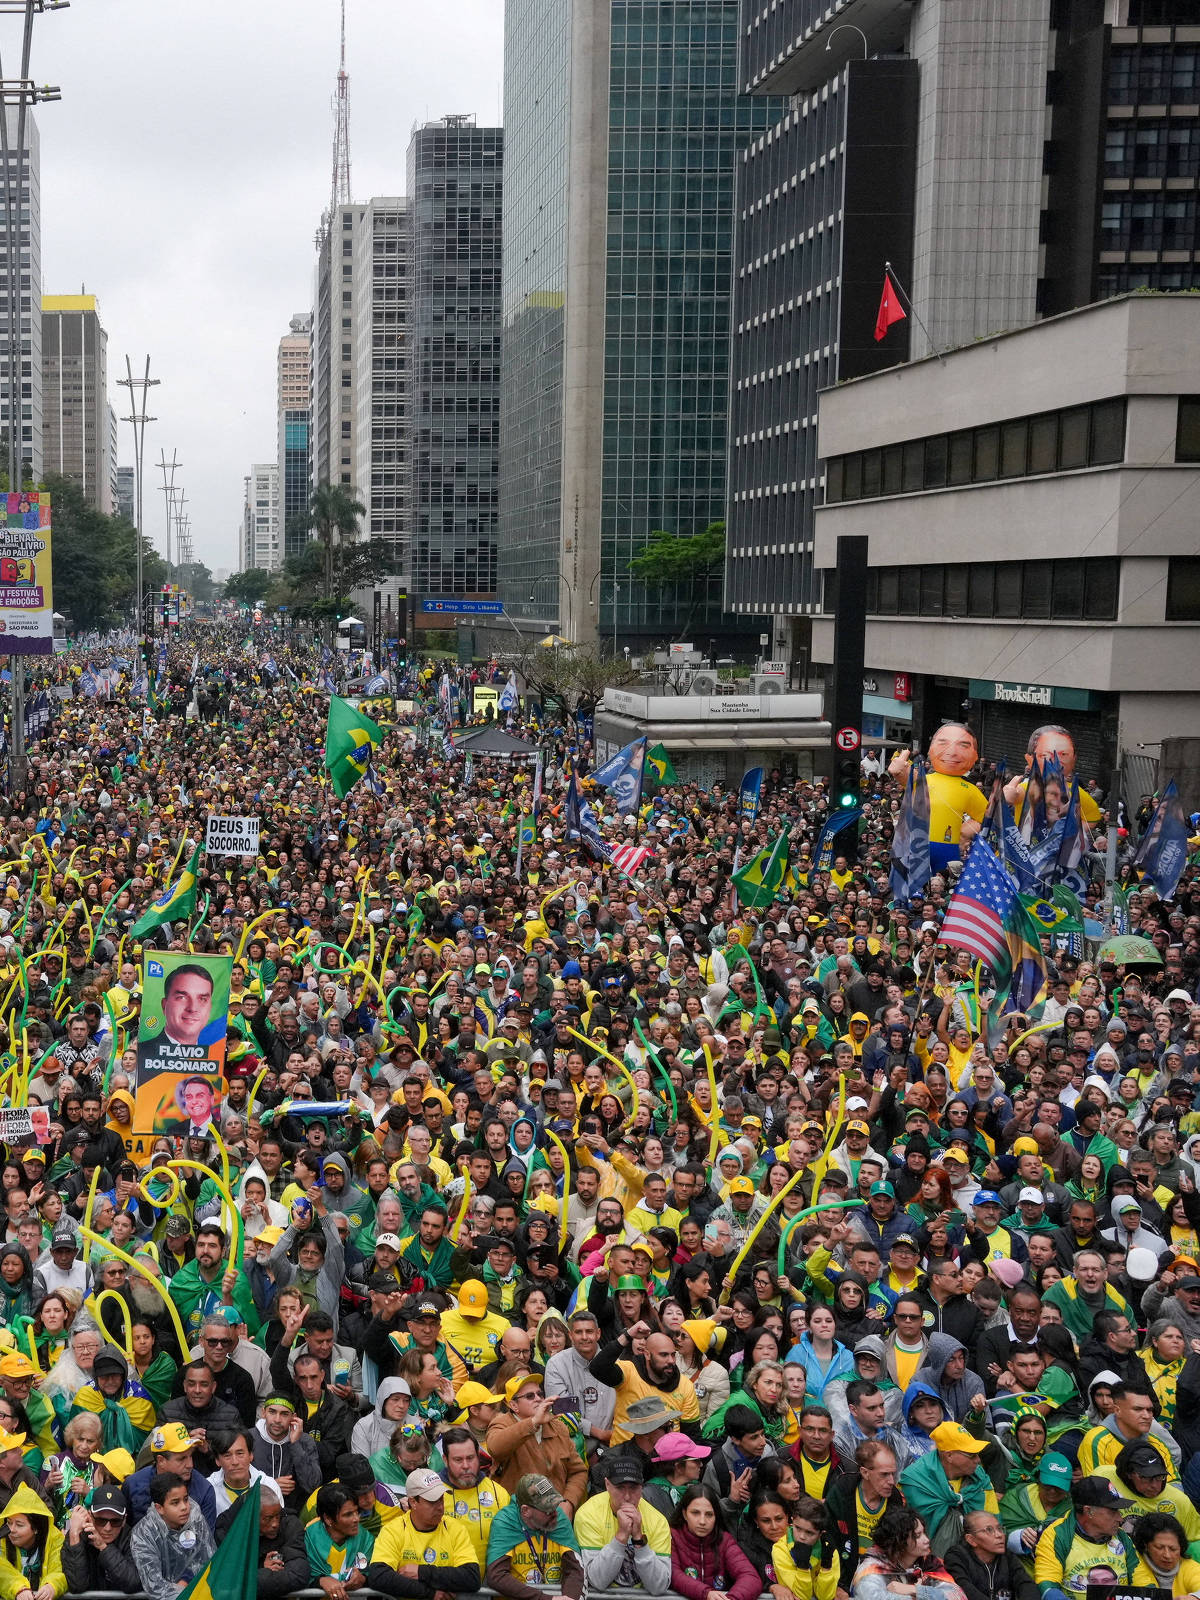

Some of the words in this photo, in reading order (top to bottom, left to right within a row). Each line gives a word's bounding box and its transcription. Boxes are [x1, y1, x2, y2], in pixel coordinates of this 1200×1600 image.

[4, 533, 37, 543] BIENAL
[20, 541, 45, 550] LIVRO
[12, 549, 35, 557] PAULO
[6, 589, 40, 597] FESTIVAL
[5, 597, 40, 607] EMOÇÕES
[896, 677, 905, 689] 24
[994, 682, 1052, 706] Brooksfield
[210, 820, 243, 834] DEUS
[247, 821, 259, 835] !!!
[208, 836, 258, 852] SOCORRO...
[150, 963, 162, 974] PL
[158, 1044, 205, 1059] FLÁVIO
[144, 1058, 217, 1073] BOLSONARO
[464, 1346, 483, 1365] 22
[1159, 1503, 1176, 1513] 222
[1084, 1557, 1105, 1568] ACIMA
